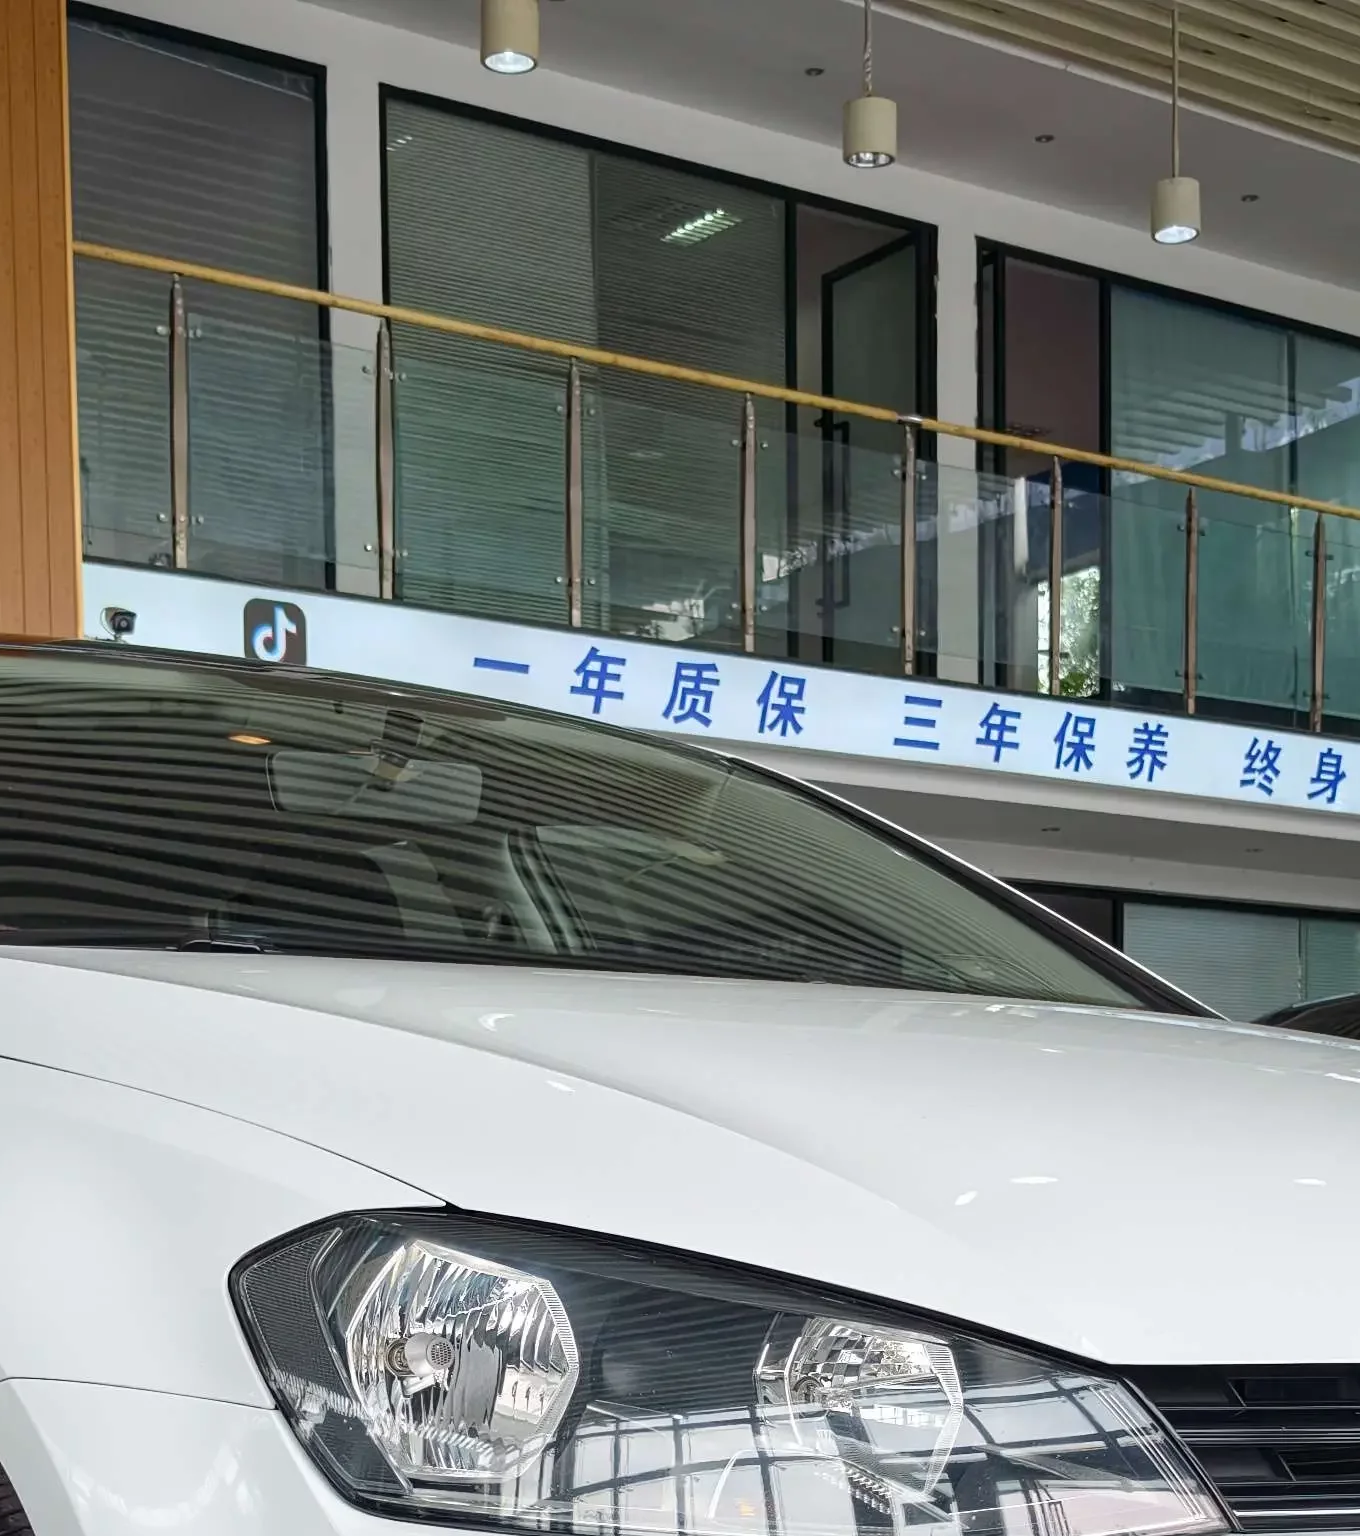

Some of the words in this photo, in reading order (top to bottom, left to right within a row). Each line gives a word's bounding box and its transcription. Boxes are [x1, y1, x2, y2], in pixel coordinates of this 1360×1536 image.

[472, 645, 808, 738] 一年质保
[893, 694, 1170, 784] 三年保养
